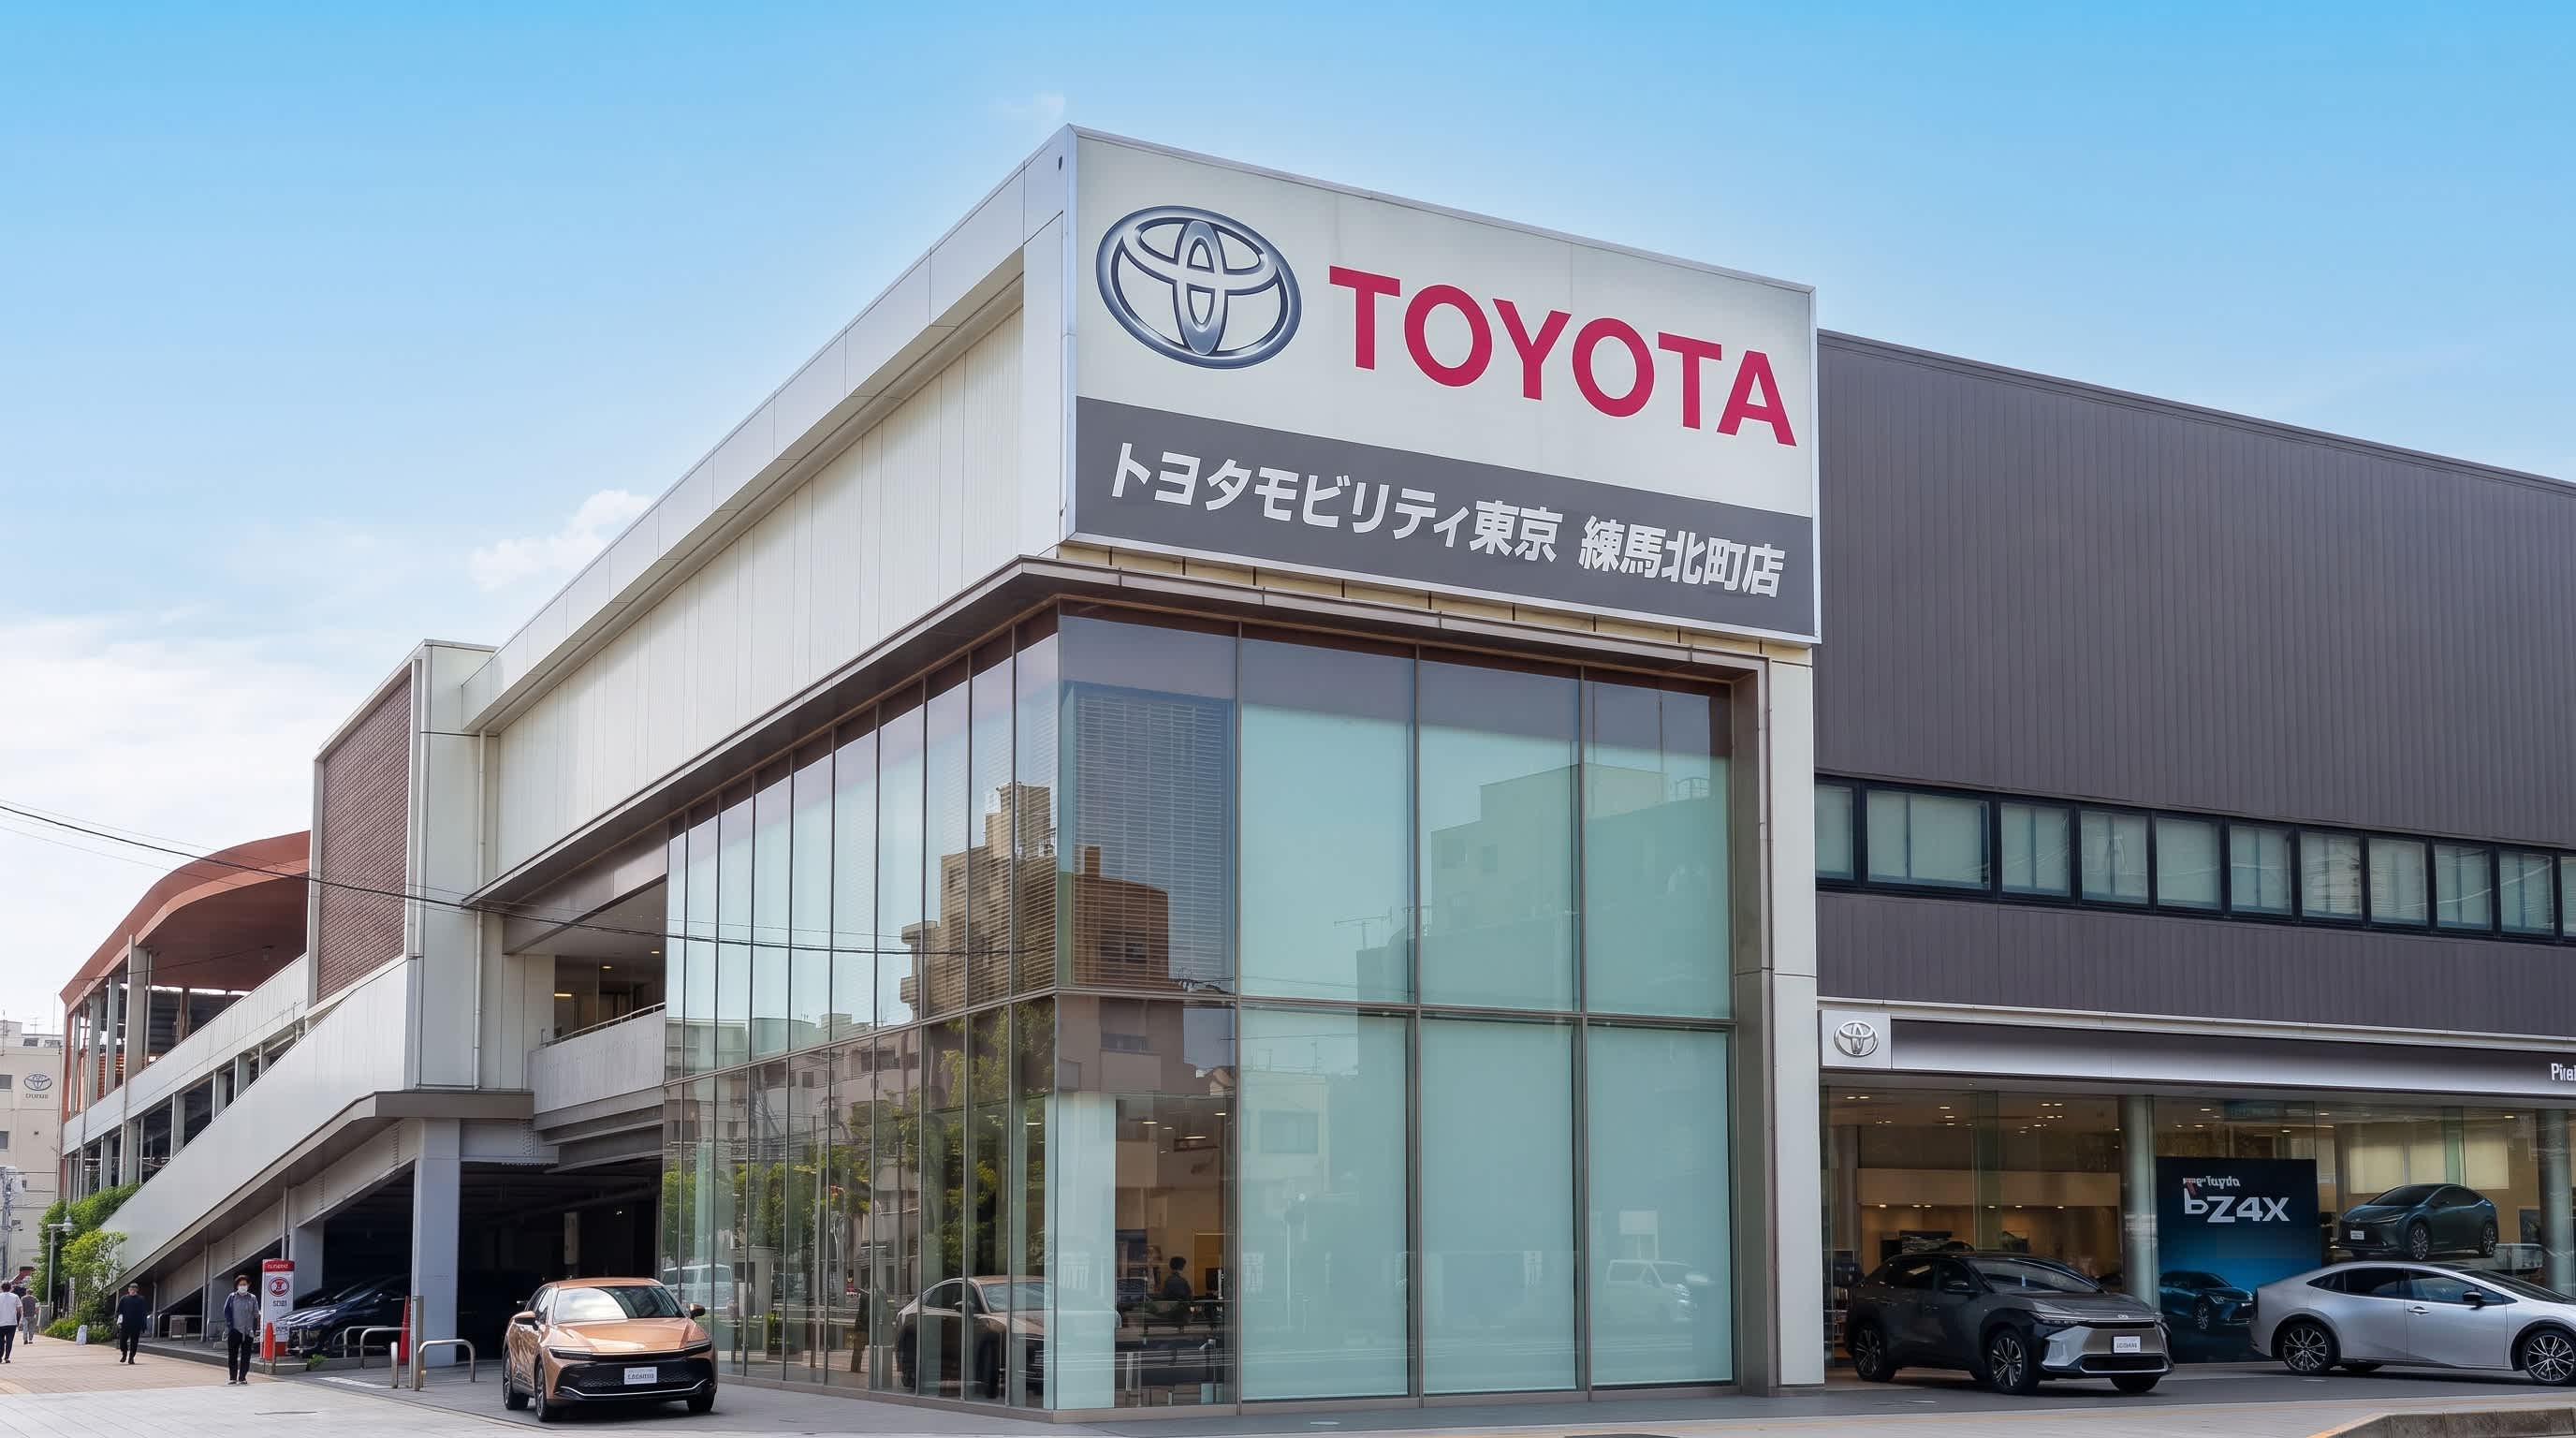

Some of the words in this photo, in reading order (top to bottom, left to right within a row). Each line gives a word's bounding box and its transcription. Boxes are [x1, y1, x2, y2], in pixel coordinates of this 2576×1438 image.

[1329, 265, 1796, 447] TOYOTA
[1111, 442, 1564, 563] トヨタモビリティ東京
[1578, 515, 1786, 598] 練馬北町店
[2183, 1187, 2291, 1223] bZ4X
